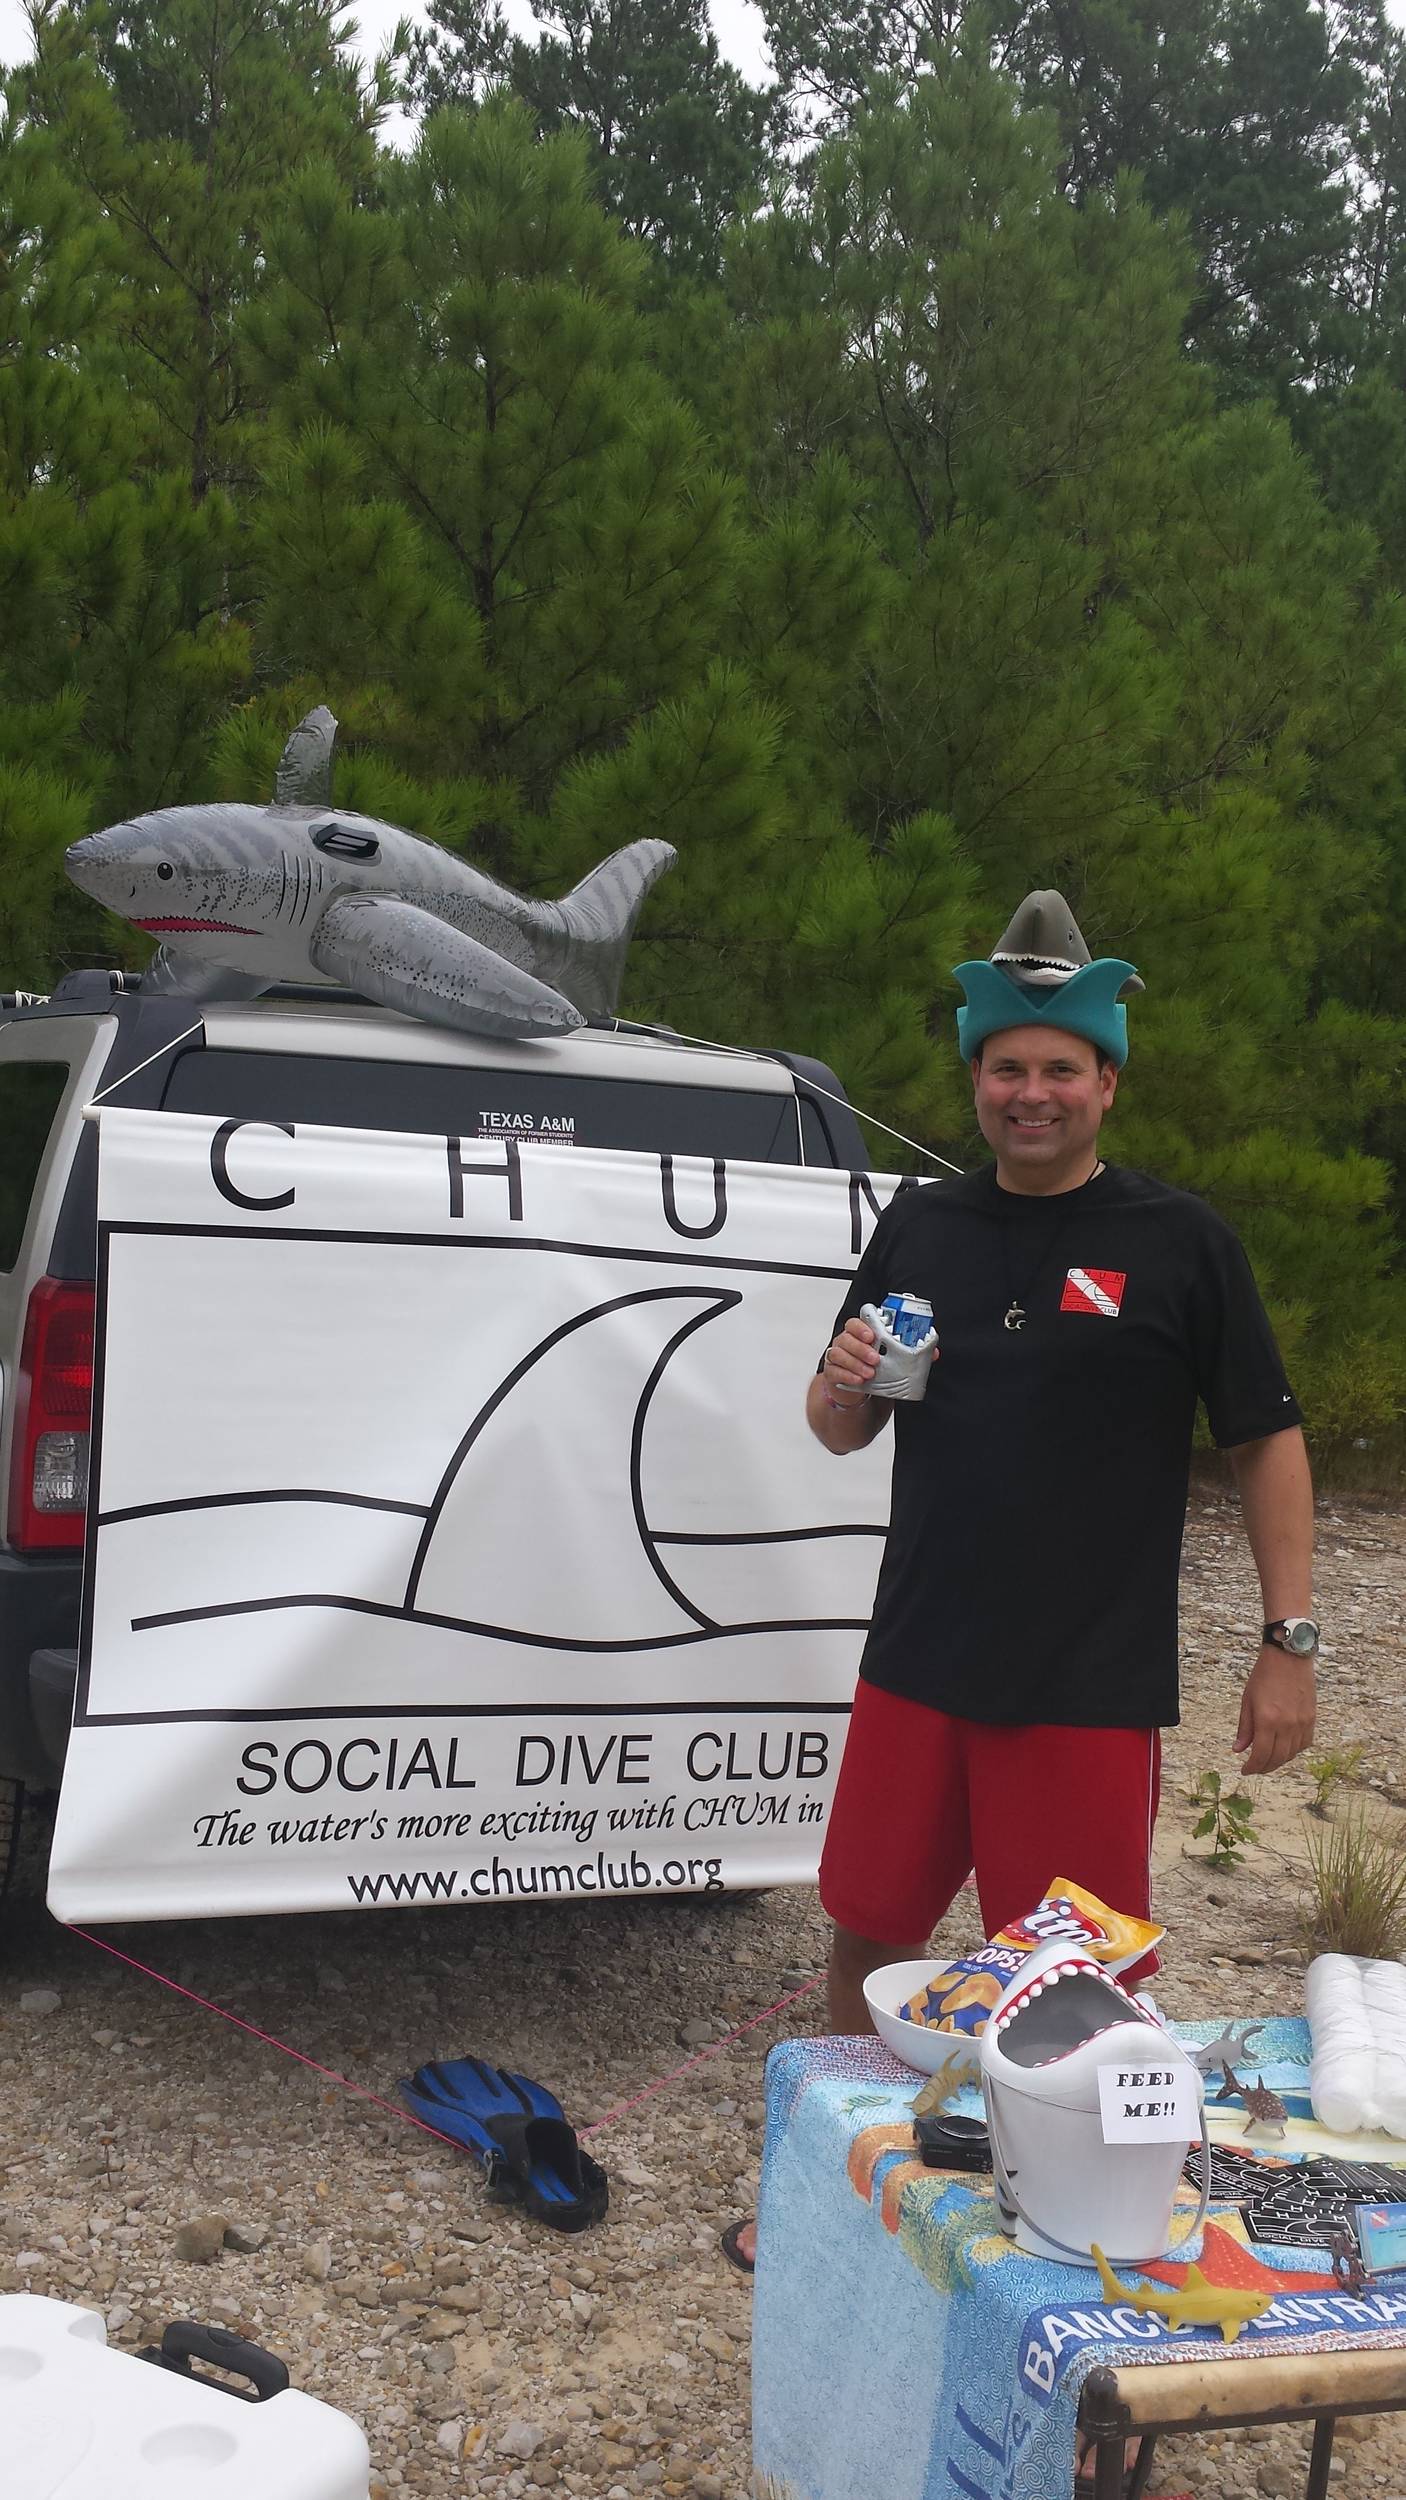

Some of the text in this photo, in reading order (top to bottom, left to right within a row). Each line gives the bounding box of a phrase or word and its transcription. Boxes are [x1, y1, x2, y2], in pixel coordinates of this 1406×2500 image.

[479, 1111, 575, 1132] TEXAS A&M
[237, 1732, 829, 1795] SOCIAL DIVE CLUB
[194, 1809, 257, 1847] The
[267, 1809, 388, 1845] water's
[397, 1812, 476, 1839] more
[480, 1800, 599, 1843] exciting
[607, 1795, 677, 1832] with
[684, 1792, 789, 1831] CHUM
[347, 1850, 725, 1903] www.chumclub.org
[1116, 2072, 1175, 2087] FEED
[1123, 2102, 1175, 2117] ME!!
